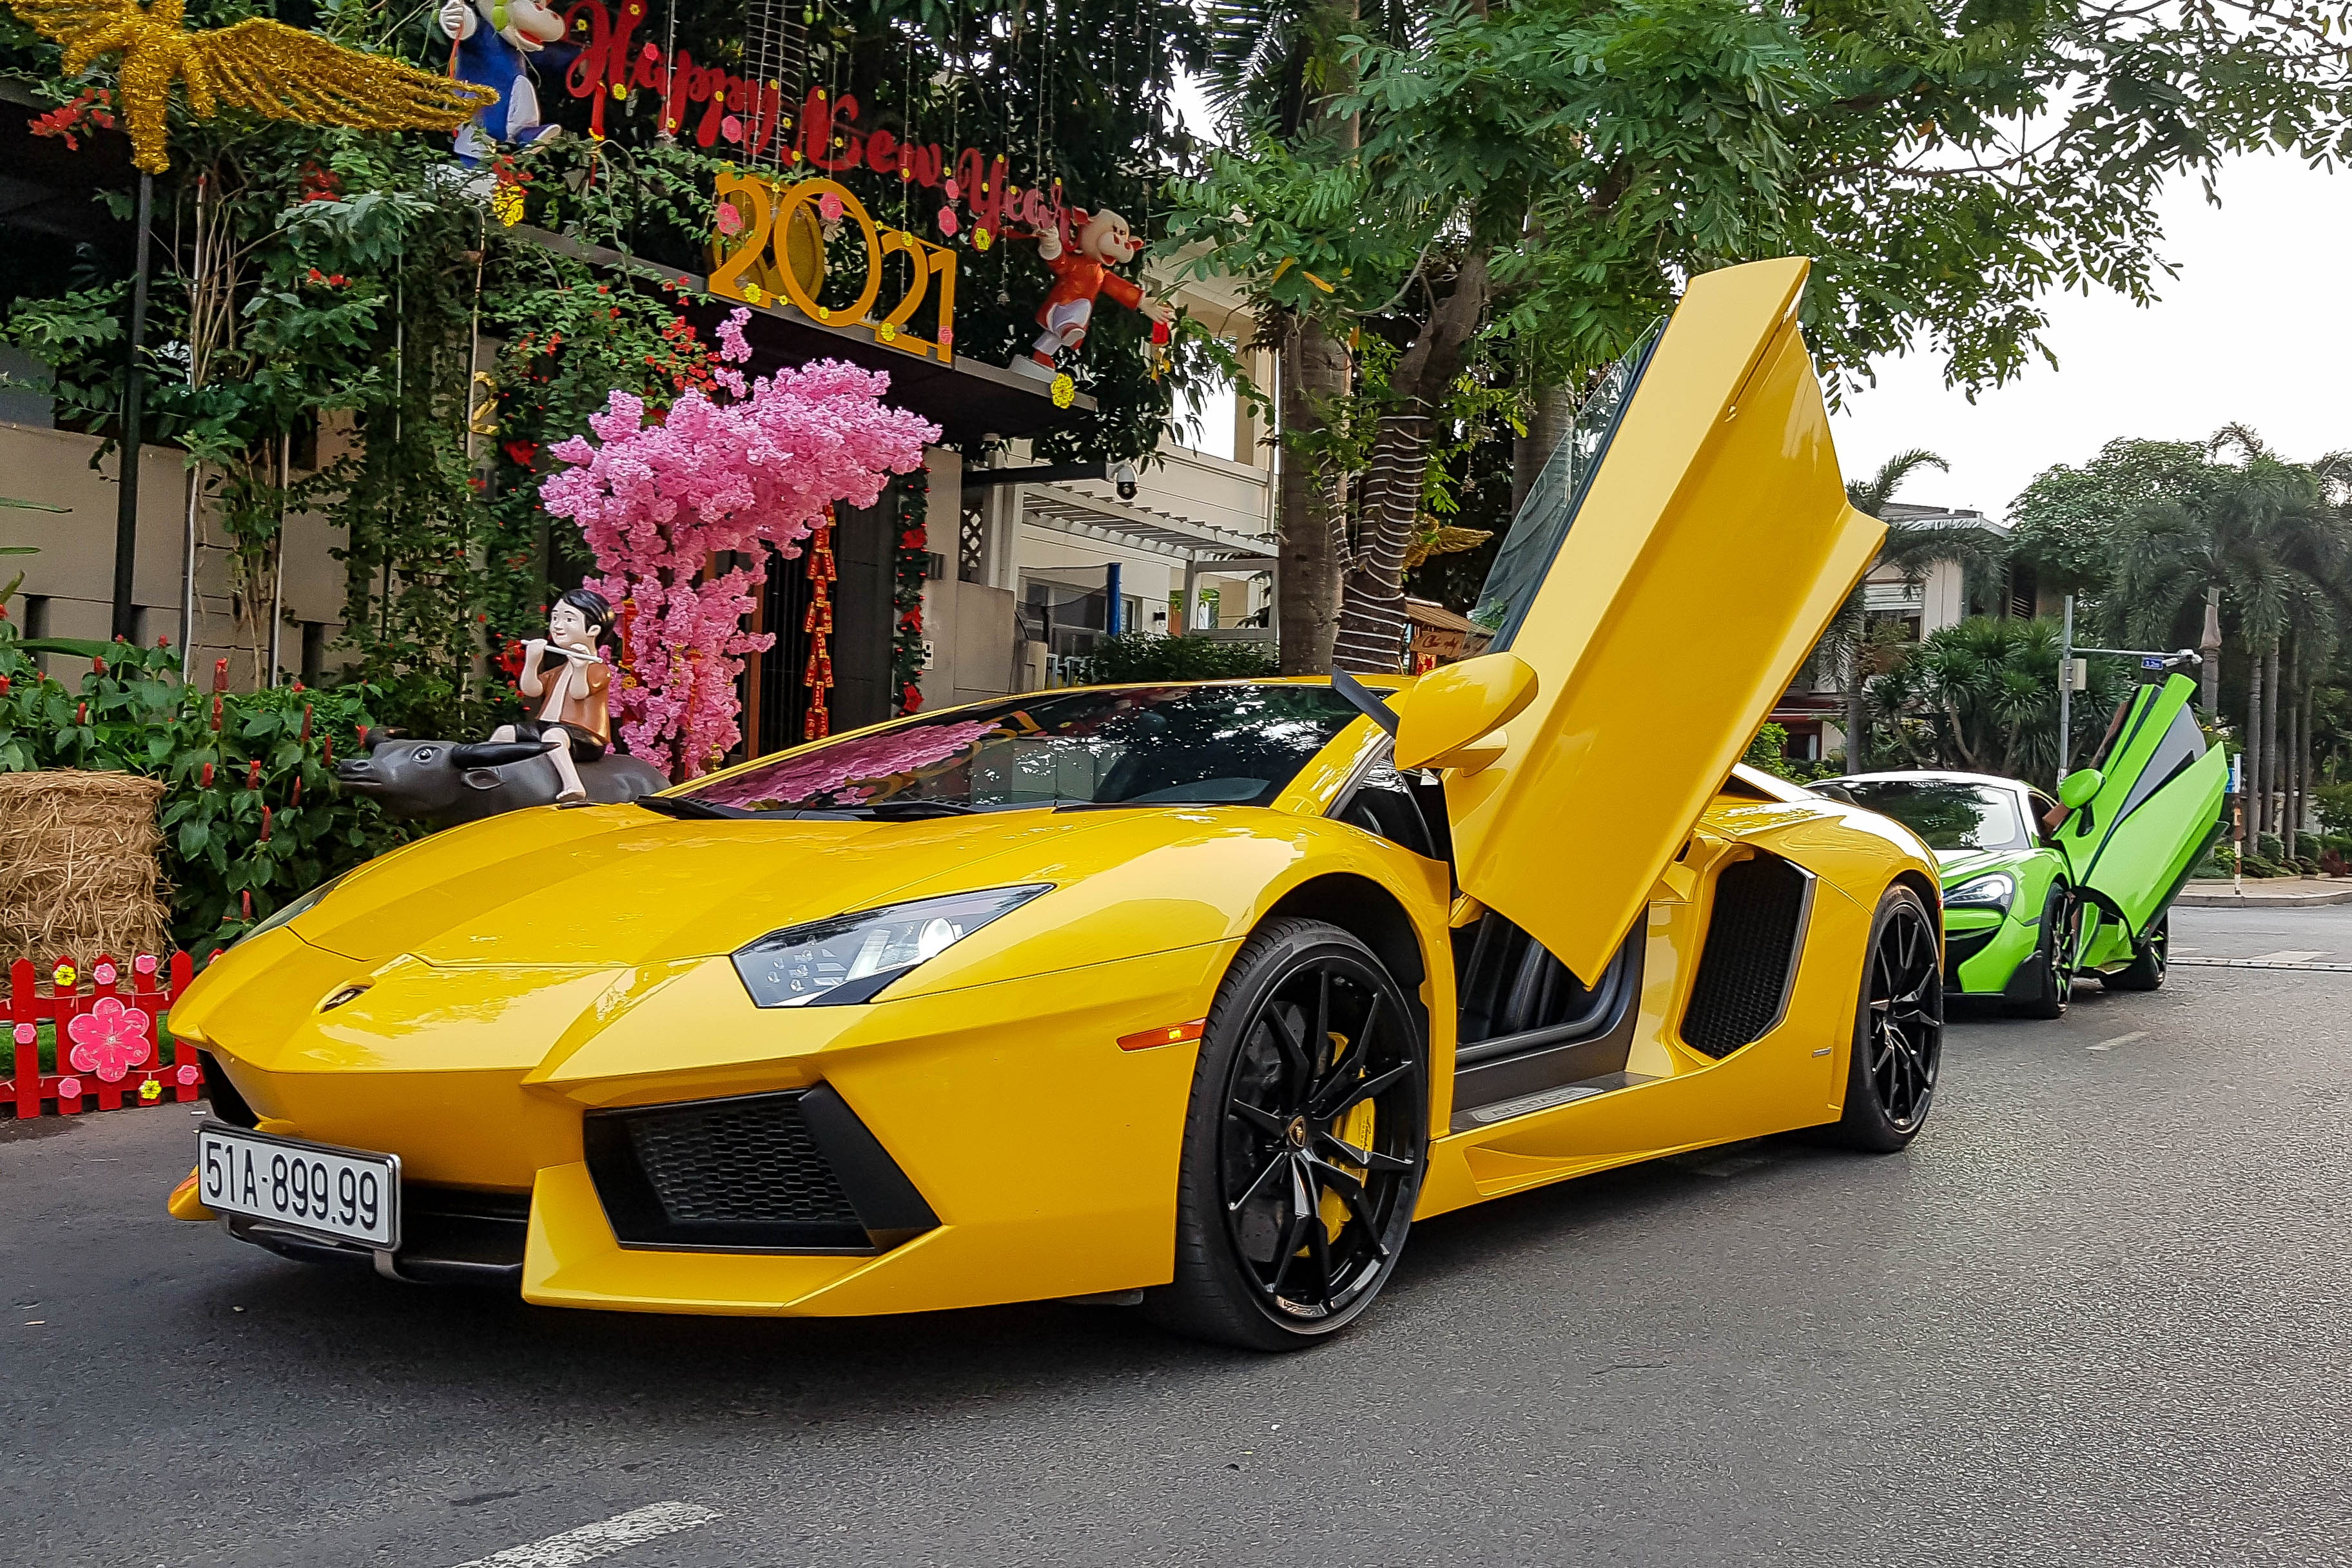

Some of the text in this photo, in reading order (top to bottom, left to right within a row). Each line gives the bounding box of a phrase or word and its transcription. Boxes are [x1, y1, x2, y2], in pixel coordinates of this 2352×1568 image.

[565, 0, 1082, 252] Happy New Year
[709, 173, 957, 363] 2021
[206, 1140, 378, 1230] 51A-899.99
